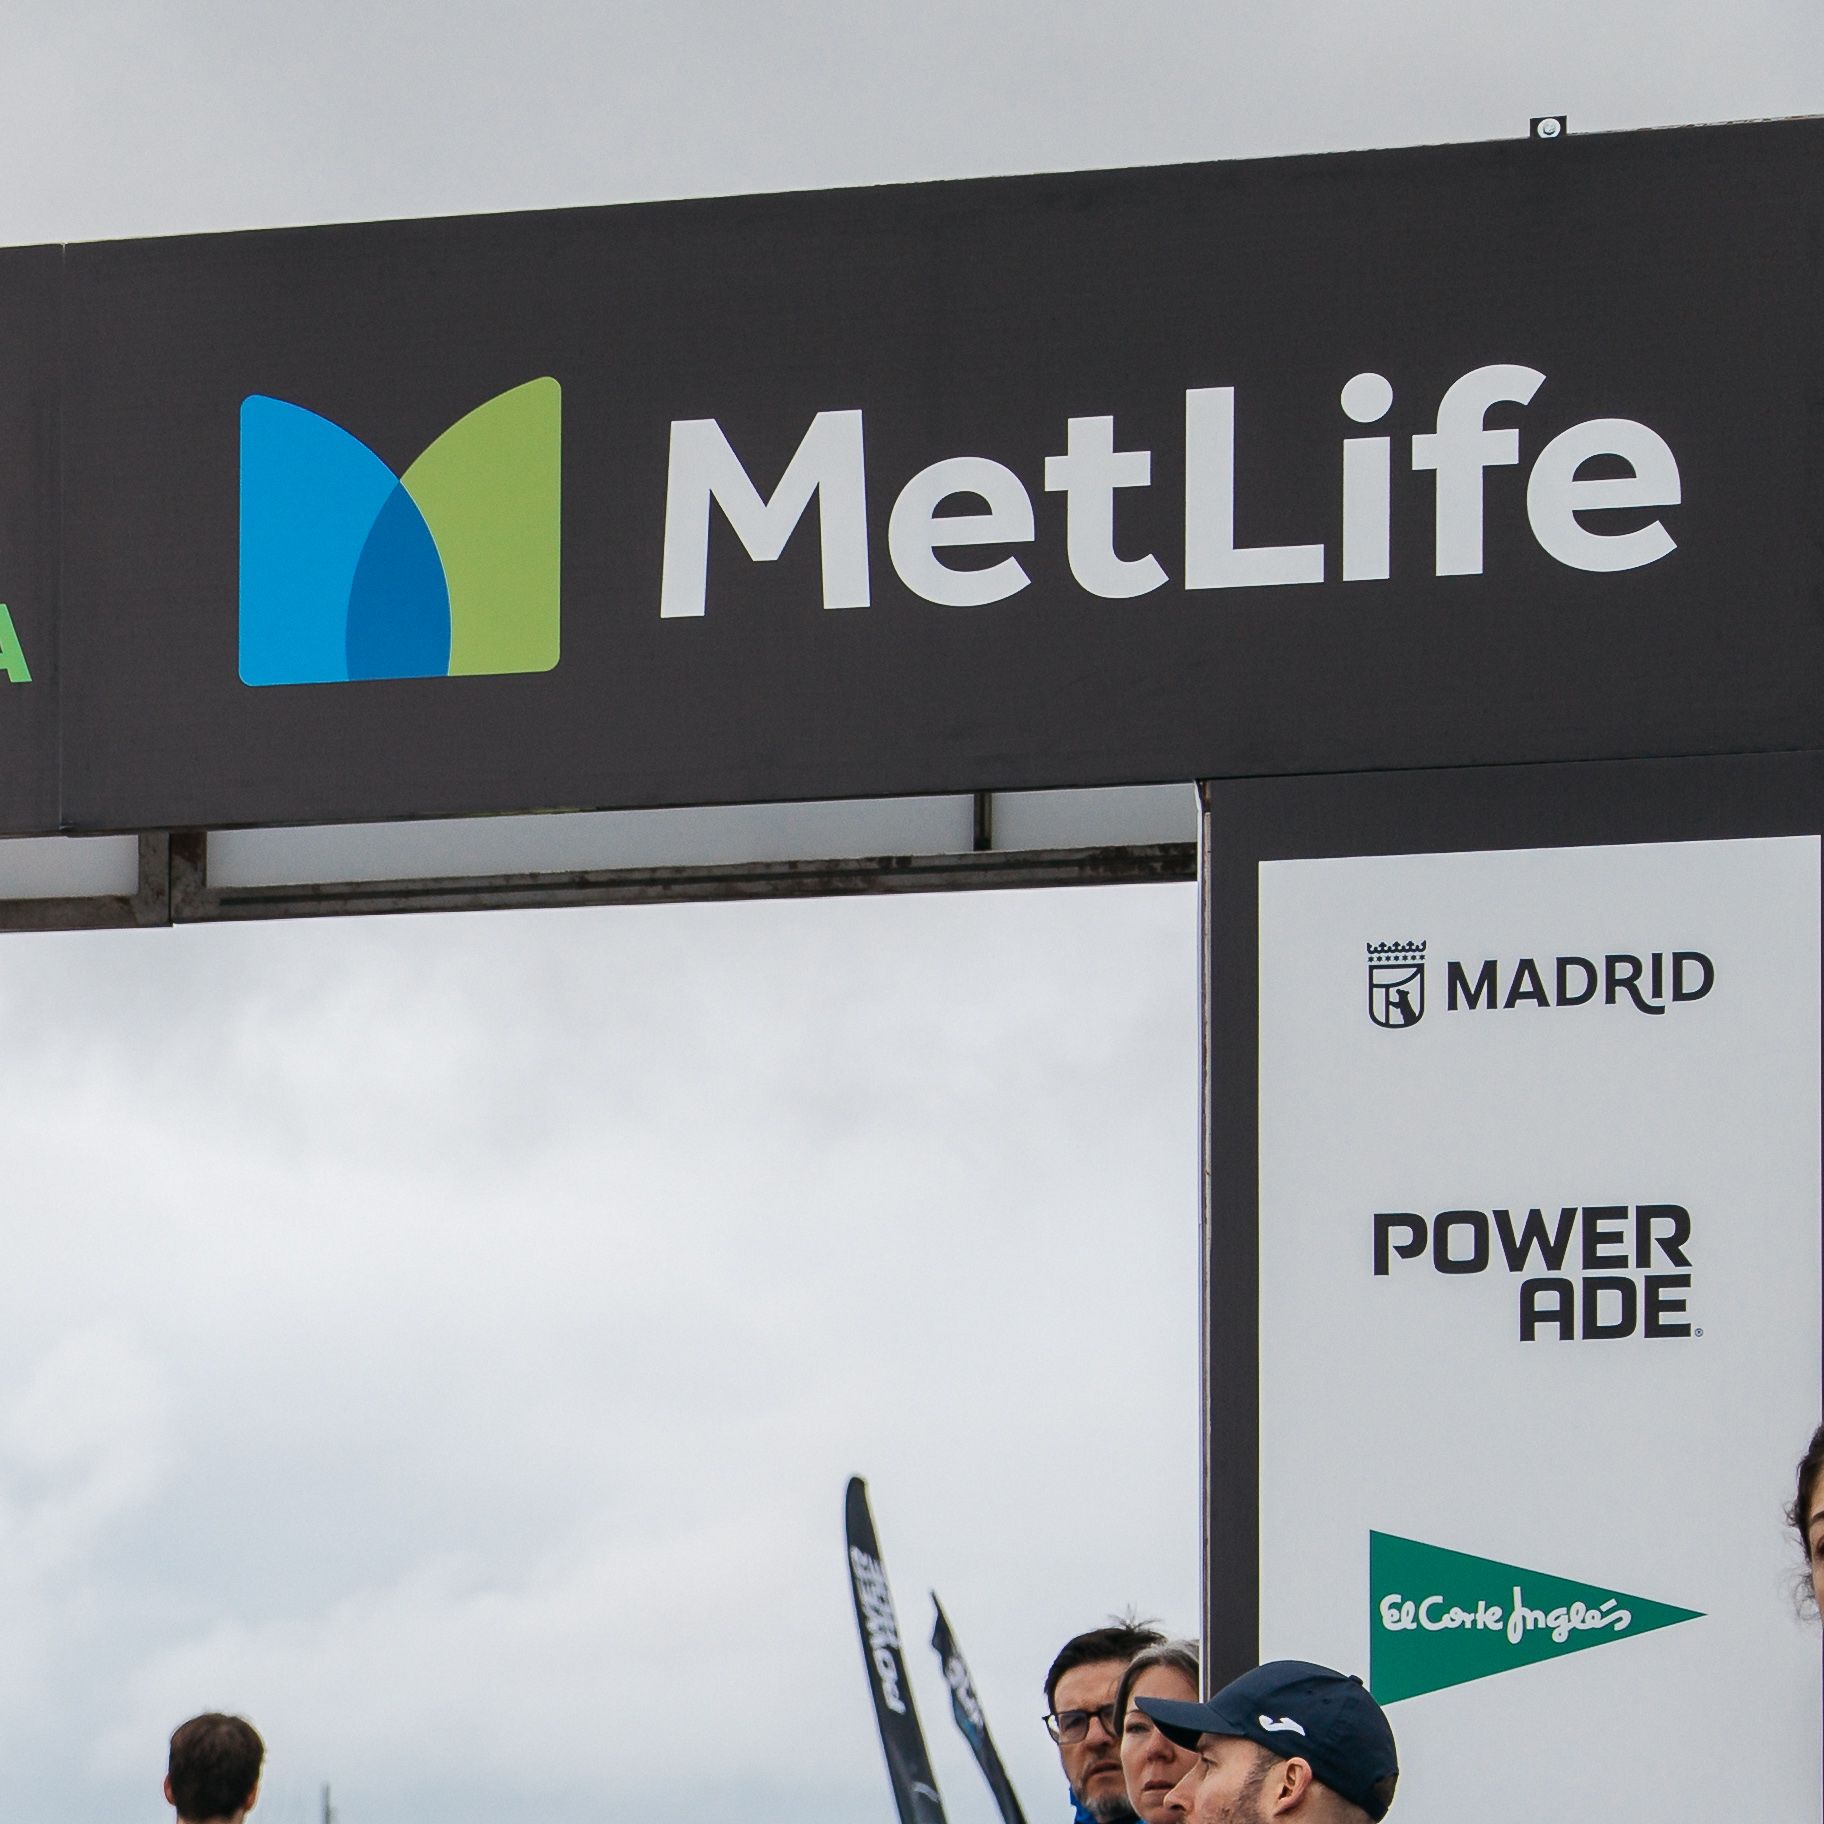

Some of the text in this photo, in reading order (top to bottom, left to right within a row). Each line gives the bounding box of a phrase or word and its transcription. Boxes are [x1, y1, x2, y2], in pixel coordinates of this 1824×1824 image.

[660, 363, 1681, 618] MetLife
[1446, 949, 1715, 1016] MADRID
[1373, 1203, 1692, 1276] POWER
[1519, 1274, 1692, 1342] ADE
[1379, 1586, 1632, 1645] El Corte Inglés
